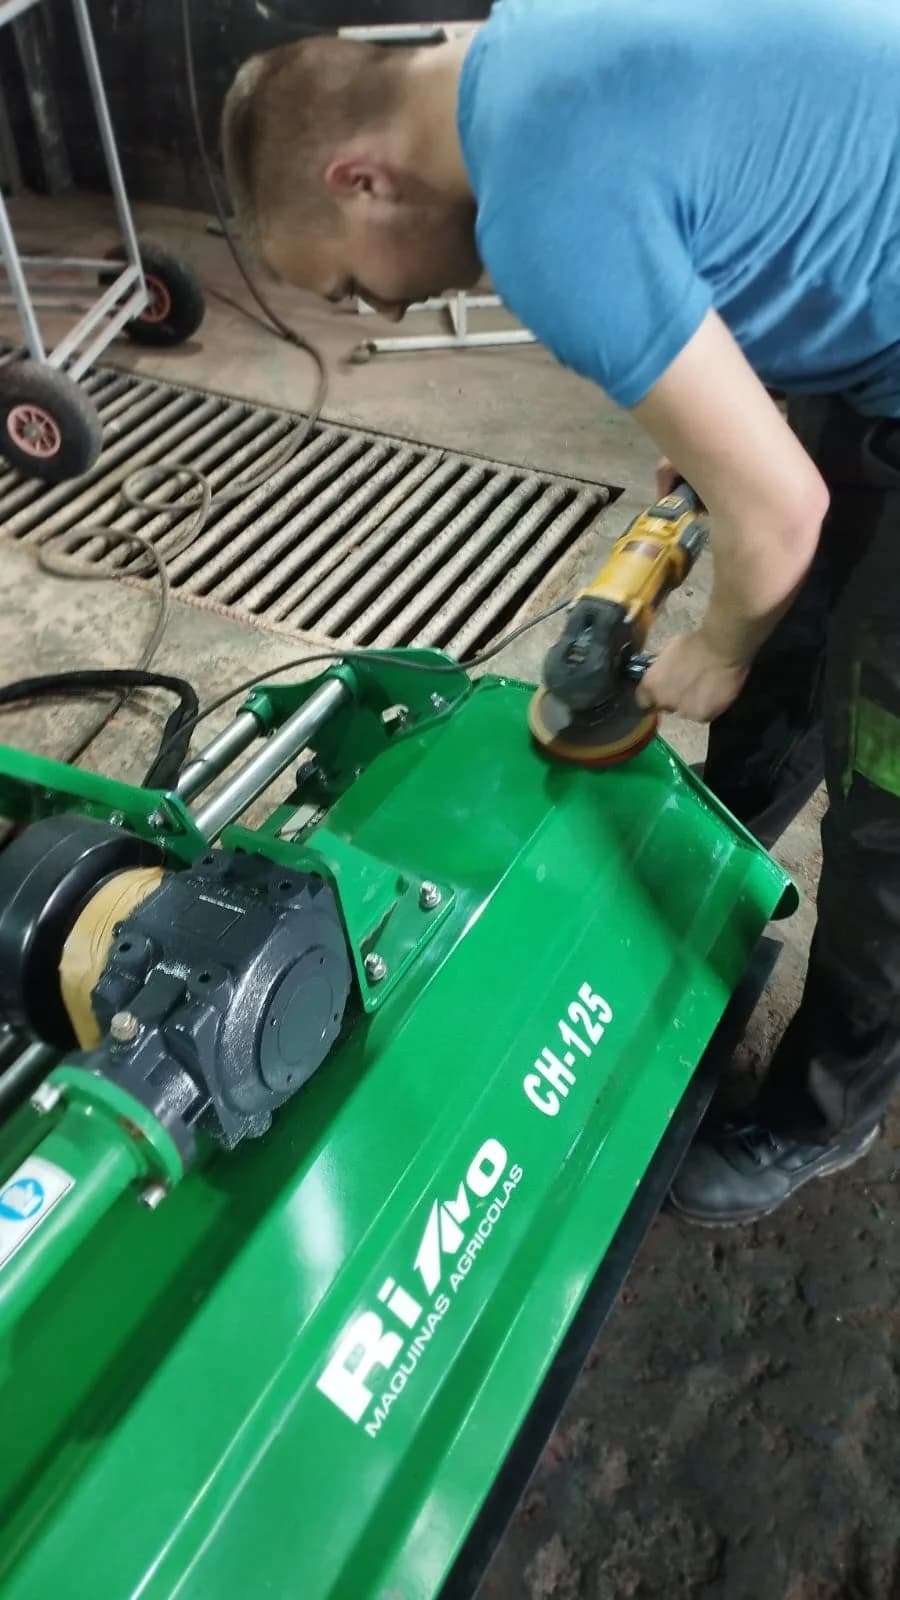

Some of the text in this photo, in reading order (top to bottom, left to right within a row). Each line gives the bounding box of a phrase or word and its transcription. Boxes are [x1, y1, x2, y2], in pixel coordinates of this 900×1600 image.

[523, 982, 613, 1117] CH-125
[364, 1164, 523, 1438] MAQUINAS AGRICOLAS
